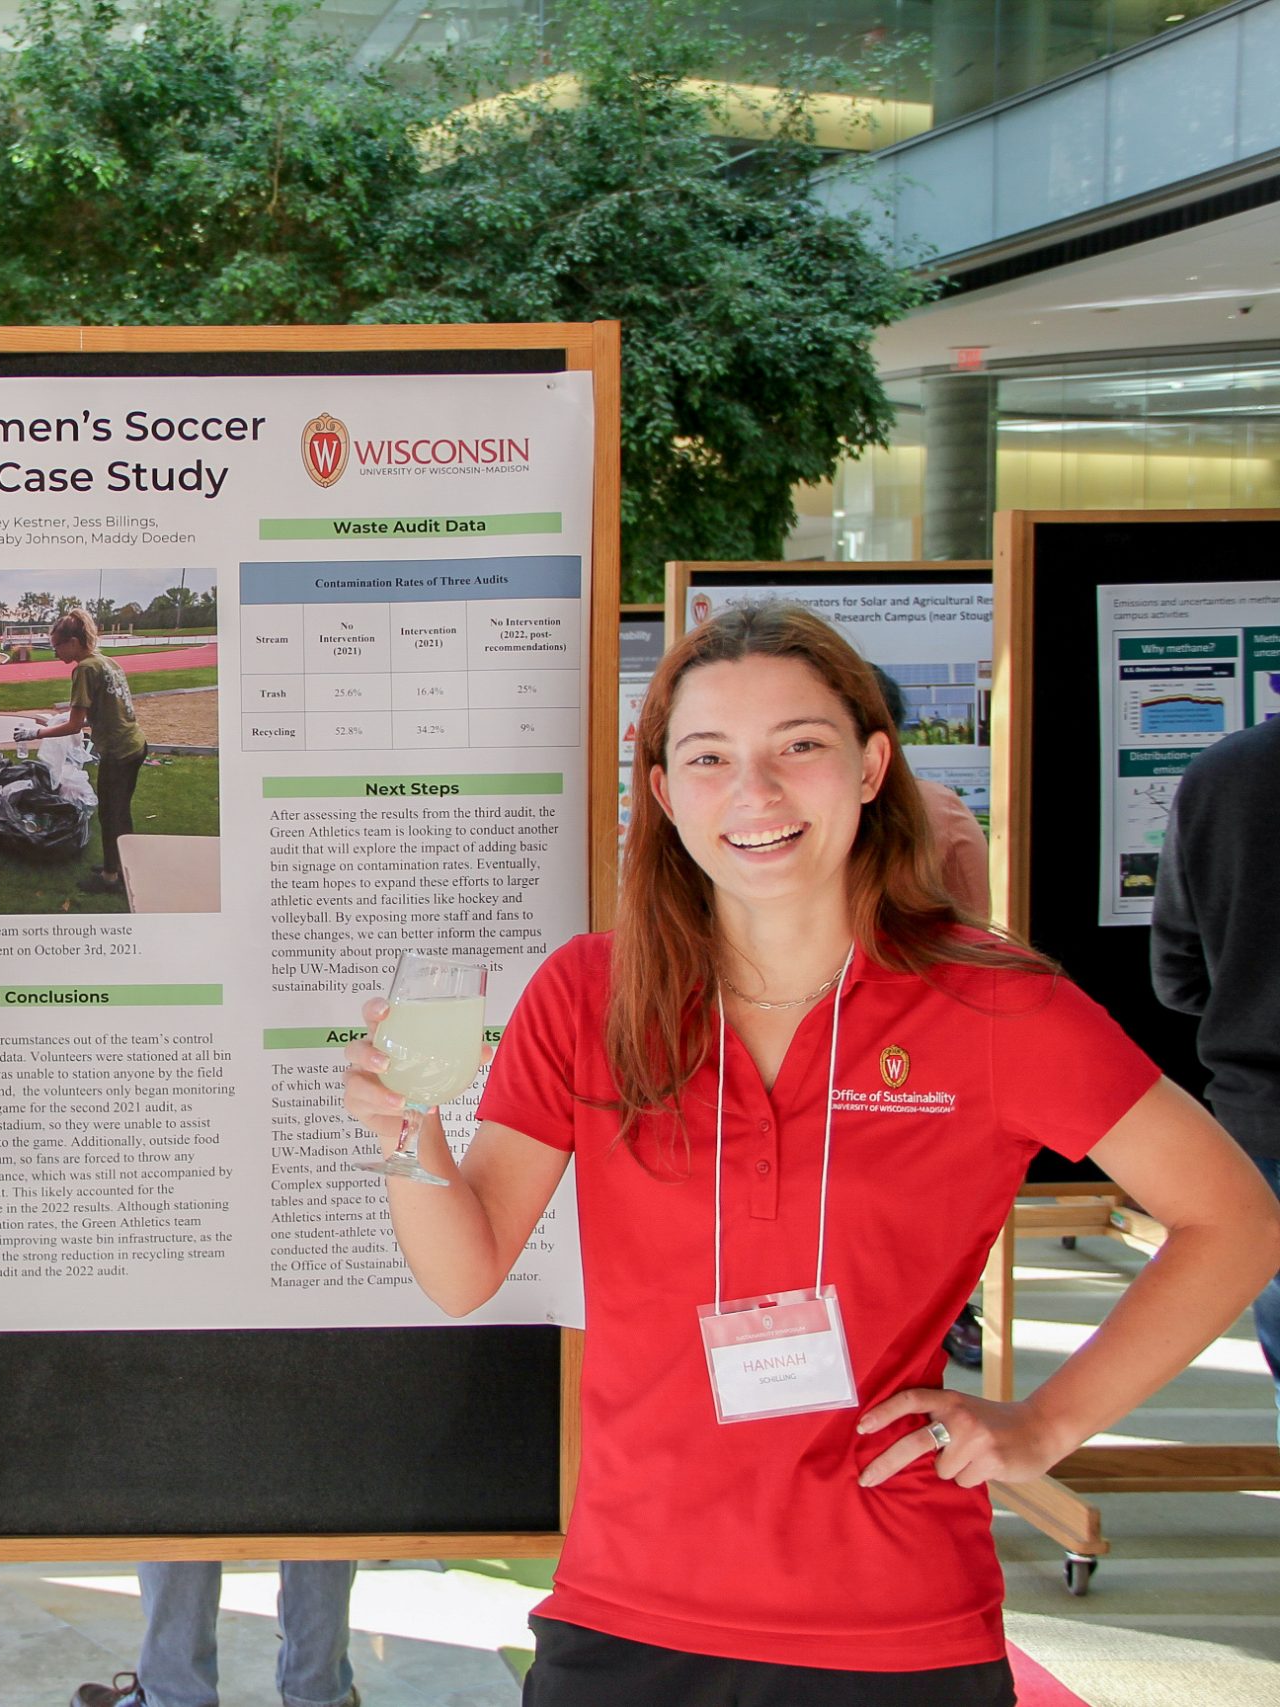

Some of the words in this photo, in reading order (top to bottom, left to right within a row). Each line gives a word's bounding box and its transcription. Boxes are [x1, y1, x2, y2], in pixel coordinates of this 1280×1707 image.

[125, 410, 265, 441] Soccer
[353, 438, 529, 465] WISCONSIN
[359, 467, 412, 476] UNIVERSITY
[414, 467, 427, 475] OF
[107, 458, 228, 499] Study
[13, 516, 69, 529] Kestner,
[72, 515, 102, 527] Jess
[105, 515, 158, 530] Billings,
[333, 520, 388, 534] Waste
[392, 518, 440, 533] Audit
[445, 519, 485, 532] Data
[25, 532, 87, 545] Johnson,
[91, 531, 138, 546] Maddy
[141, 531, 195, 543] Doeden
[314, 577, 392, 588] Contamination
[395, 577, 424, 587] Rates
[426, 576, 438, 586] of
[439, 576, 470, 585] Three
[473, 574, 508, 584] Audits
[842, 596, 858, 607] for
[860, 596, 887, 606] Solar
[889, 596, 910, 606] and
[912, 595, 974, 608] Agricultural
[490, 618, 503, 626] No
[506, 617, 560, 626] Intervention
[834, 611, 882, 622] Research
[884, 611, 926, 623] Campus
[928, 611, 957, 622] (near
[400, 626, 456, 635] Intervention
[500, 629, 528, 640] (2022,
[530, 631, 551, 640] post-
[256, 635, 288, 644] Stream
[319, 634, 374, 643] Intervention
[414, 638, 443, 648] (2021)
[333, 646, 361, 656] (2021)
[484, 642, 566, 653] recommendations)
[261, 689, 286, 698] Trash
[334, 687, 362, 697] 25.6%
[417, 687, 443, 696] 16.4%
[517, 684, 536, 694] 25%
[252, 727, 295, 738] Recycling
[335, 726, 362, 735] 52.8%
[416, 724, 444, 734] 34.2%
[520, 723, 534, 732] 9%
[365, 782, 406, 796] Next
[410, 781, 459, 797] Steps
[269, 809, 301, 820] After
[303, 808, 356, 822] assessing
[359, 808, 378, 819] the
[381, 807, 418, 819] results
[422, 807, 450, 818] from
[453, 807, 471, 818] the
[474, 806, 501, 818] third
[504, 806, 535, 818] audit,
[538, 805, 555, 817] the
[22, 927, 49, 936] sorts
[52, 924, 96, 939] through
[100, 926, 132, 935] waste
[16, 947, 31, 955] on
[34, 943, 81, 955] October
[84, 943, 106, 956] 3rd,
[109, 943, 141, 955] 2021.
[4, 988, 109, 1004] Conclusions
[832, 1089, 866, 1102] Office
[869, 1090, 882, 1102] of
[883, 1091, 956, 1105] Sustainability
[21, 1265, 41, 1277] and
[44, 1265, 62, 1276] the
[65, 1265, 93, 1276] 2022
[96, 1264, 128, 1276] audit.
[742, 1352, 807, 1373] HANNAH
[759, 1373, 797, 1385] SCHILLING
